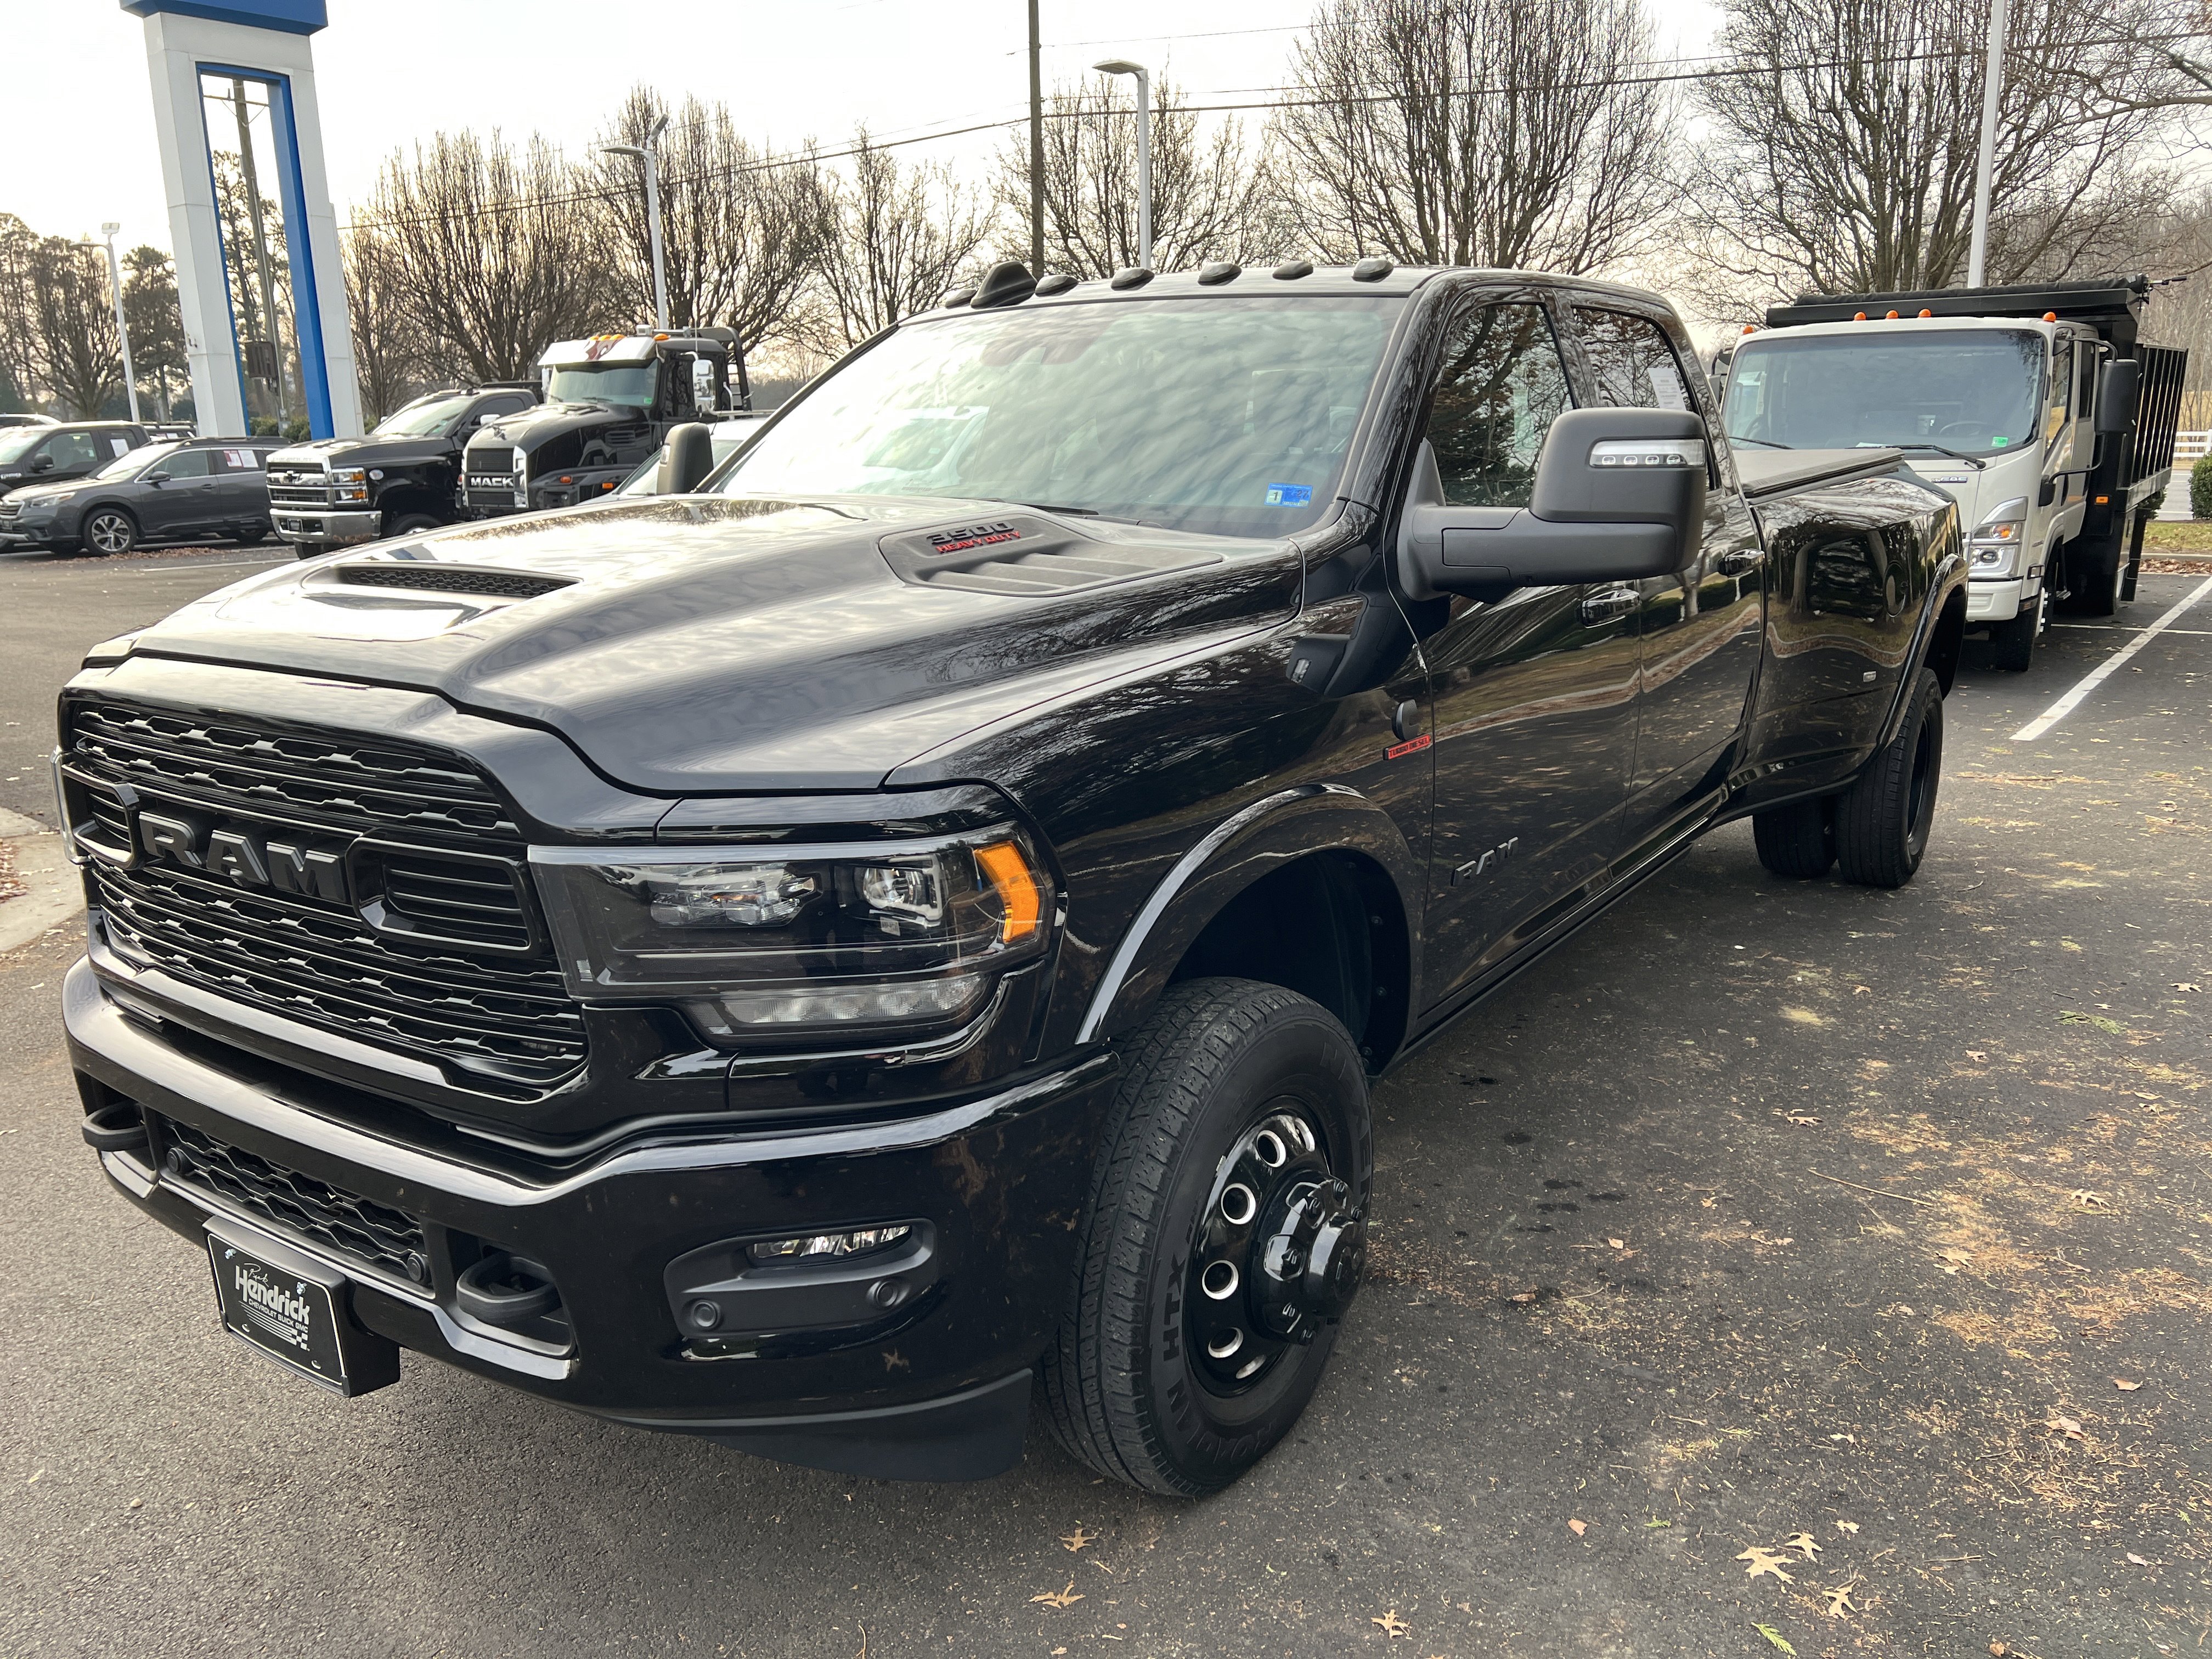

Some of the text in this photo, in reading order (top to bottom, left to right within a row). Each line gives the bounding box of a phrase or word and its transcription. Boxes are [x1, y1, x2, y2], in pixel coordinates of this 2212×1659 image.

[471, 476, 514, 487] MACK
[926, 521, 1014, 544] 3500
[935, 531, 1022, 554] HEAVY DUTY
[139, 810, 350, 903] RAM
[1450, 837, 1519, 887] RAM
[235, 1265, 311, 1325] Hendrick
[249, 1298, 308, 1334] CHEVROLET BUICK GMC
[1163, 1252, 1186, 1362] HTX
